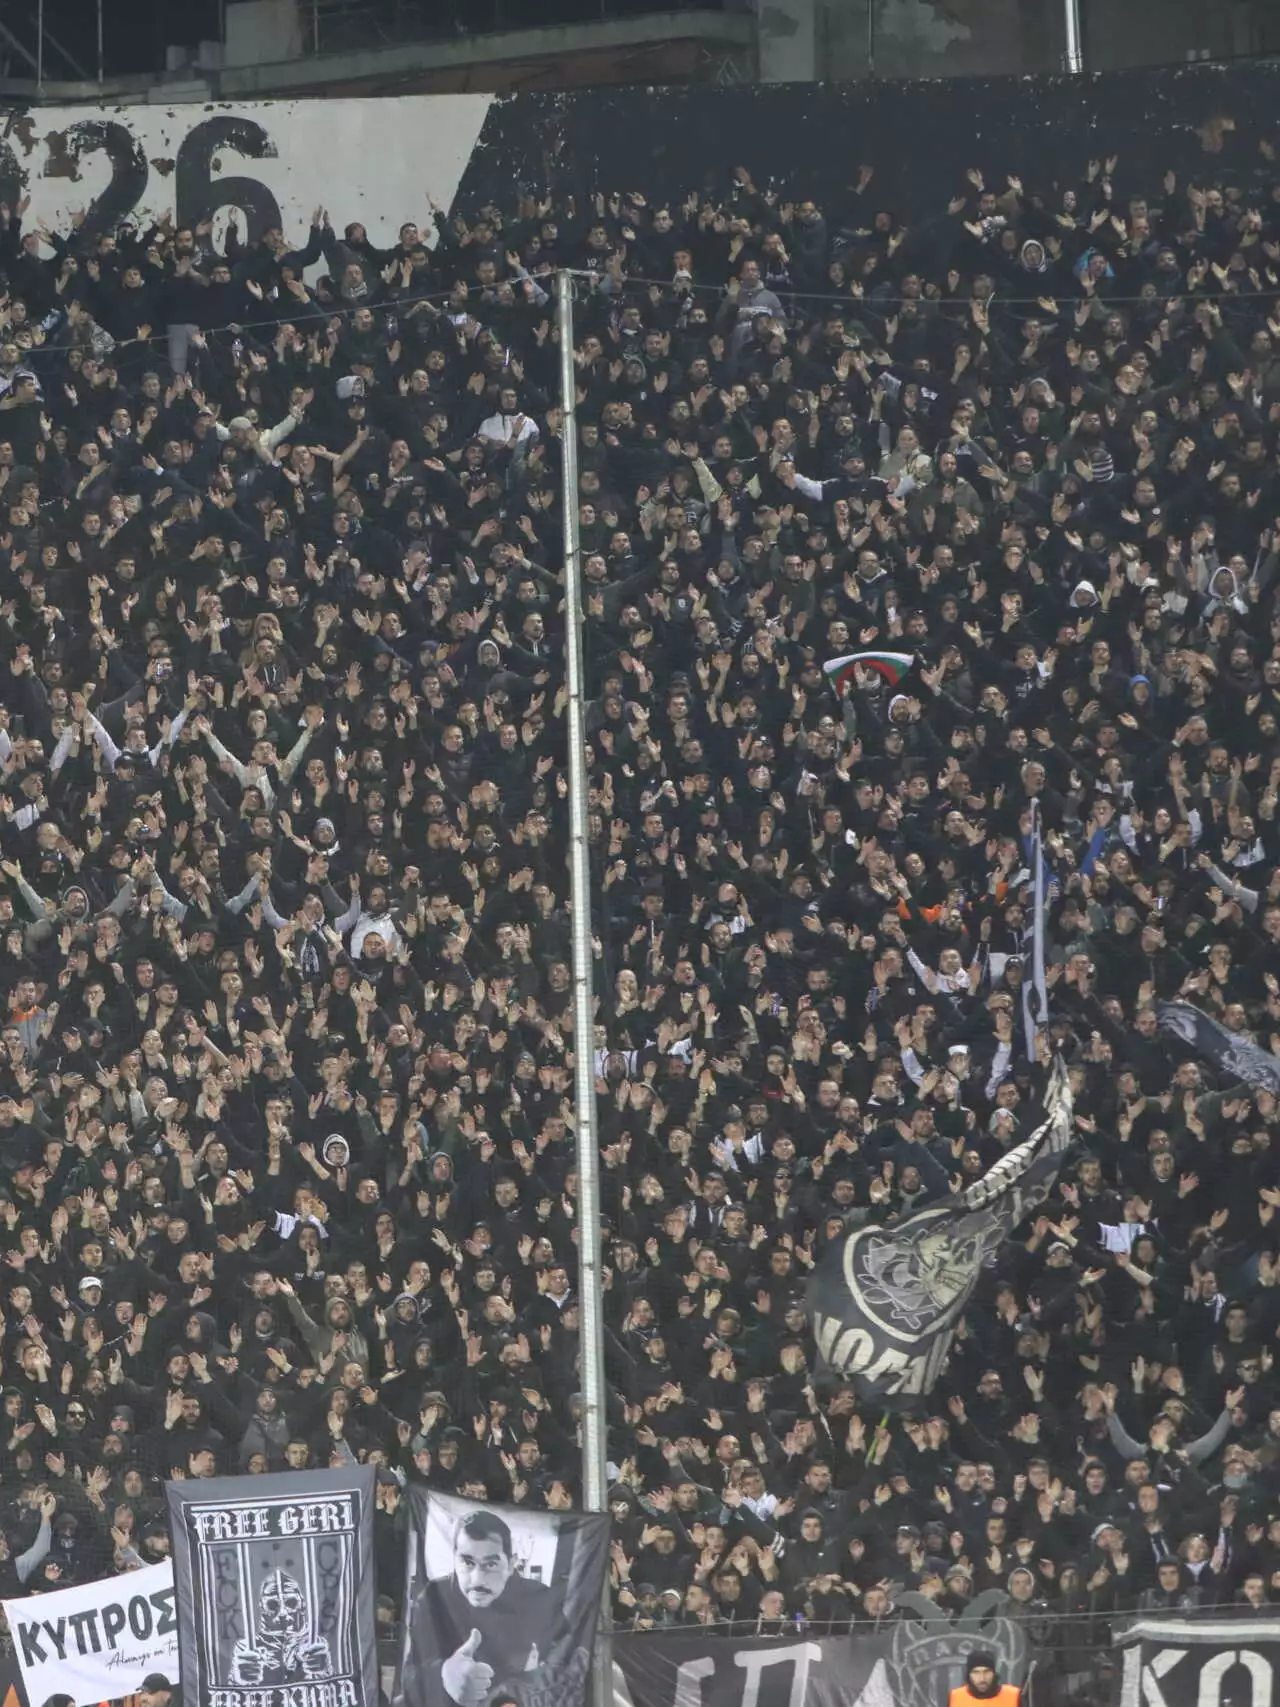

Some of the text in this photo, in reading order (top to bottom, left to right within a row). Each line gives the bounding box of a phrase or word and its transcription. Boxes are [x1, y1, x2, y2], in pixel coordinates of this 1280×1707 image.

[192, 1501, 355, 1544] FREE GERI
[17, 1586, 179, 1668] ΚΥΠΡΟΣ
[207, 1688, 274, 1707] FREE
